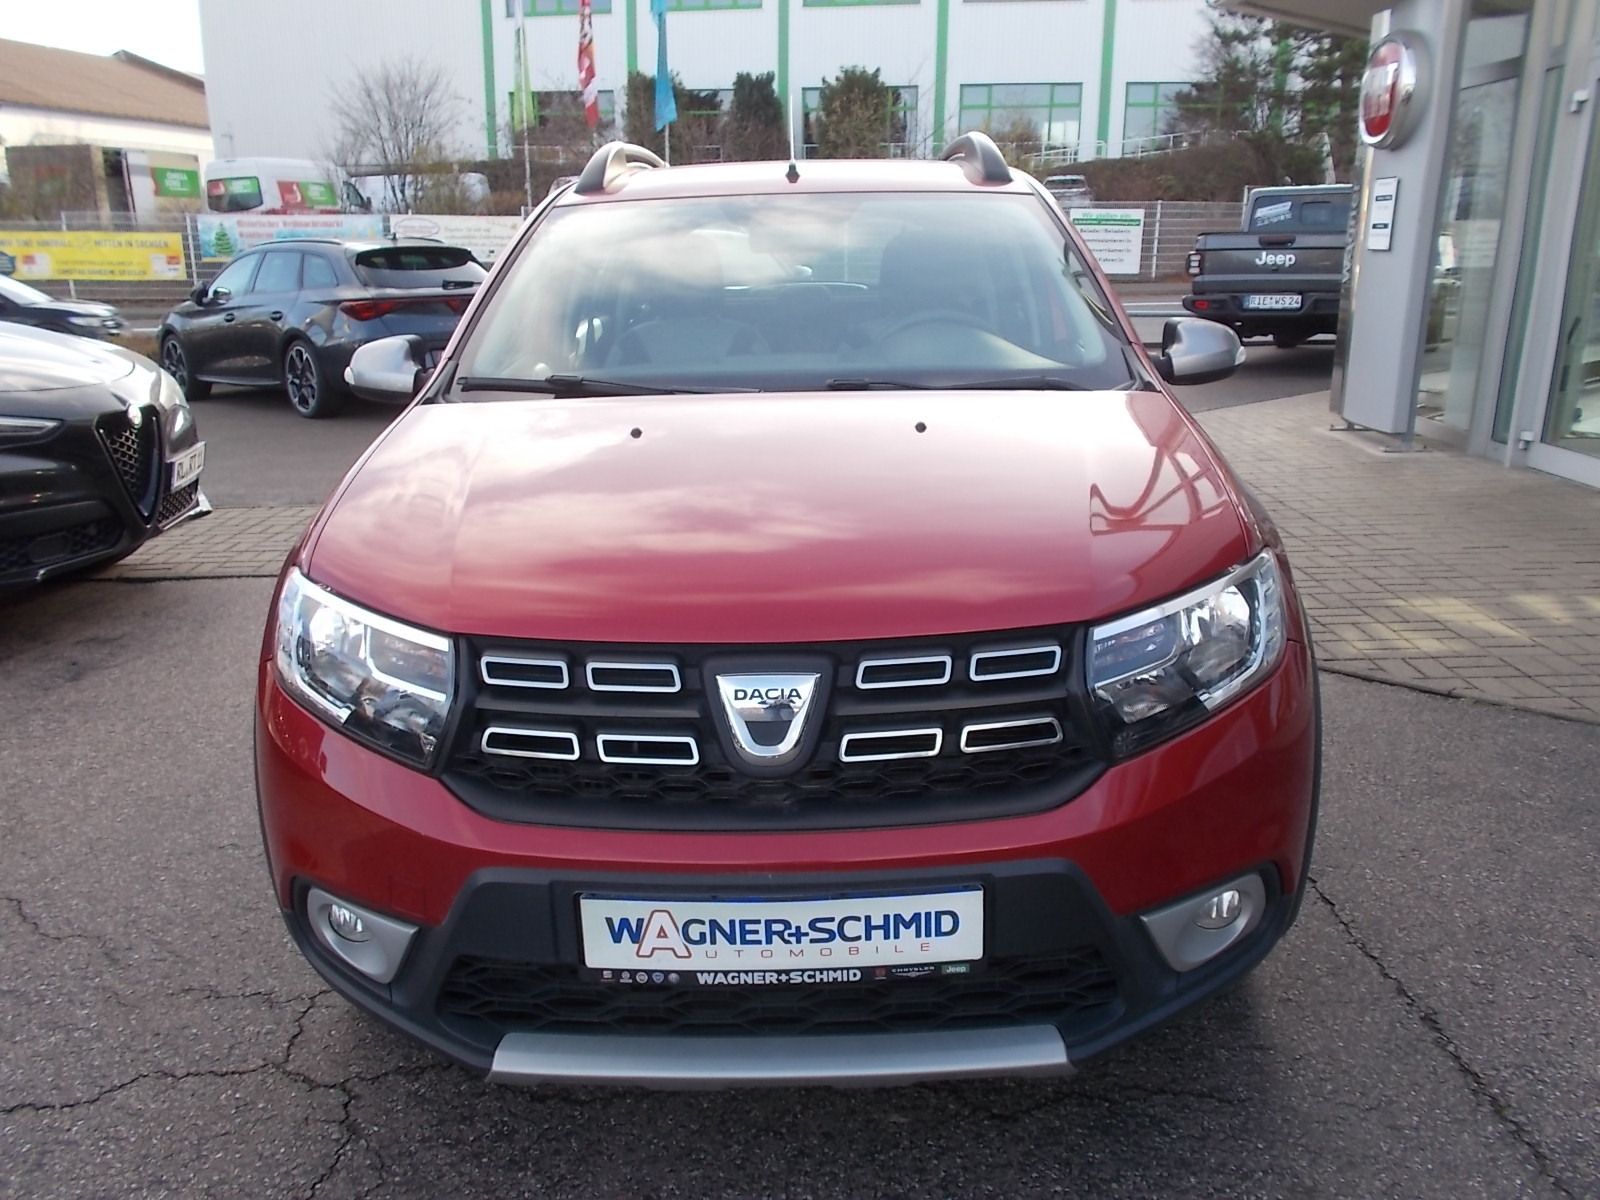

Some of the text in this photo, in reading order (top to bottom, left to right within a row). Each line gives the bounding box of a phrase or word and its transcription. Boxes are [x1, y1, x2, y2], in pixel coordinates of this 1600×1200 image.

[1255, 251, 1296, 267] Jeep
[734, 688, 803, 701] DACIA
[946, 965, 967, 974] Jeep
[696, 969, 862, 985] WAGNER+SCHMID
